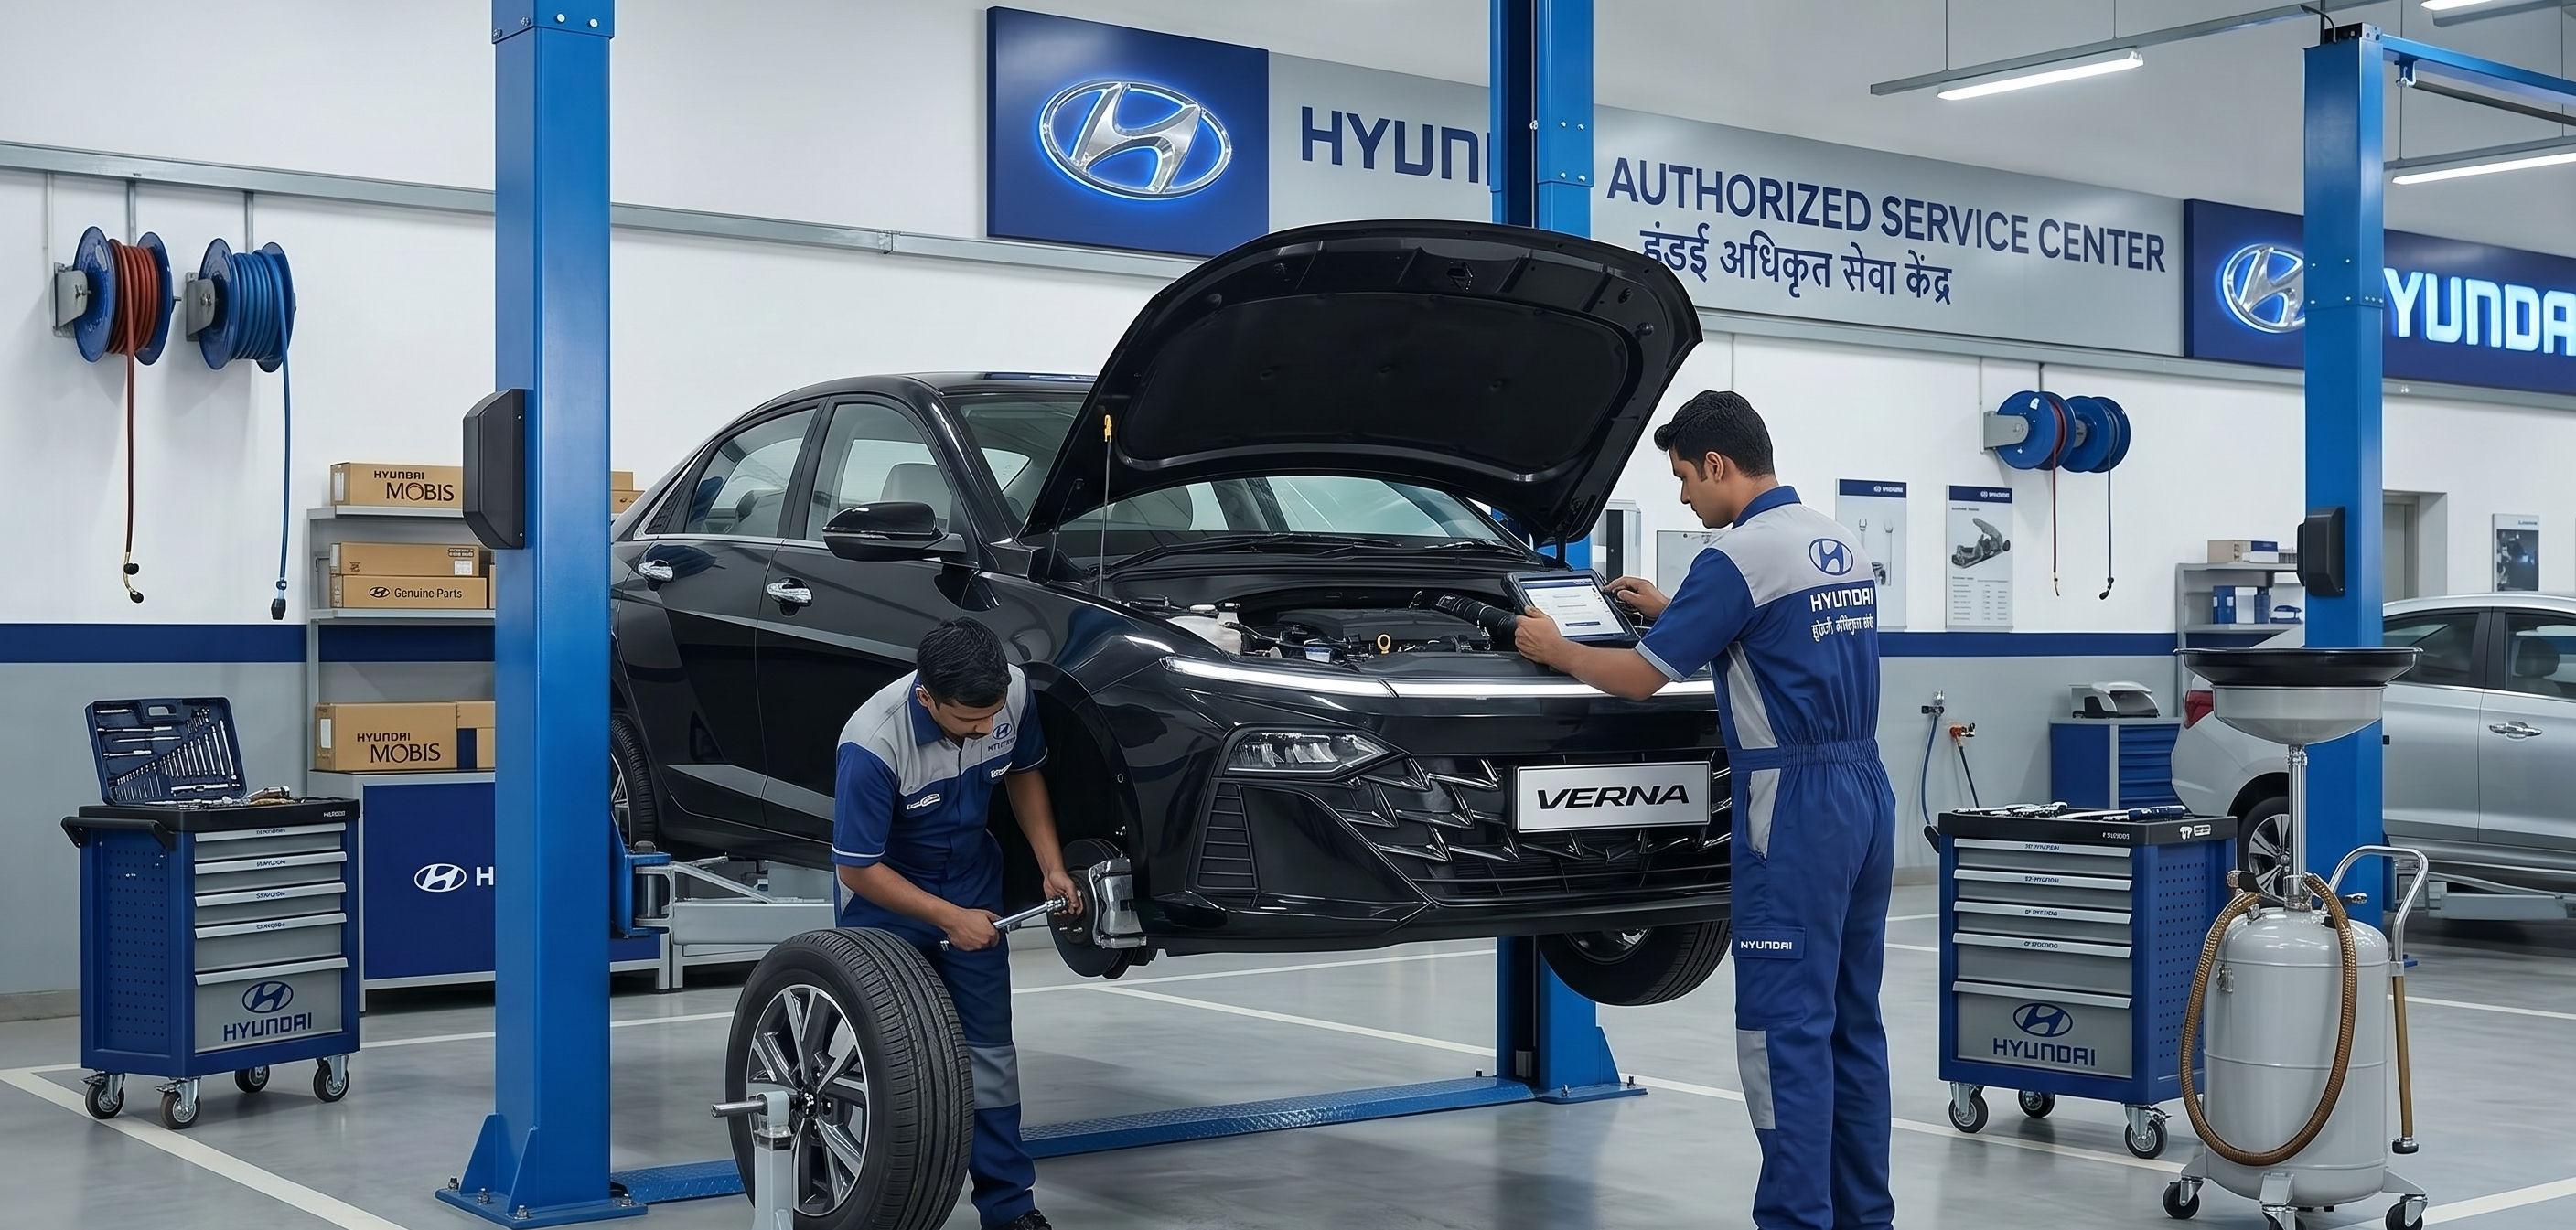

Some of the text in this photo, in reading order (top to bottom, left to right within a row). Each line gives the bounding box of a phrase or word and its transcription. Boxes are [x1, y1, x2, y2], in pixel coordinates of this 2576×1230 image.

[1301, 105, 1491, 187] HYUN
[1606, 156, 2166, 273] AUTHORIZED SERVICE CENTER
[1720, 230, 1833, 298] अधिकृत
[1841, 241, 1896, 295] सेवा
[1904, 249, 1952, 305] केंद्र
[2383, 267, 2576, 357] YUNDA
[386, 482, 455, 501] MOBIS
[394, 587, 463, 599] Genuine Parts
[1810, 587, 1873, 613] HYUNDAI
[357, 732, 411, 743] HYUNDAI
[370, 743, 441, 763] MOBIS
[1537, 784, 1690, 810] VERNA
[224, 1011, 312, 1042] HYUNDAI
[1992, 1037, 2096, 1067] HYUNDAI
